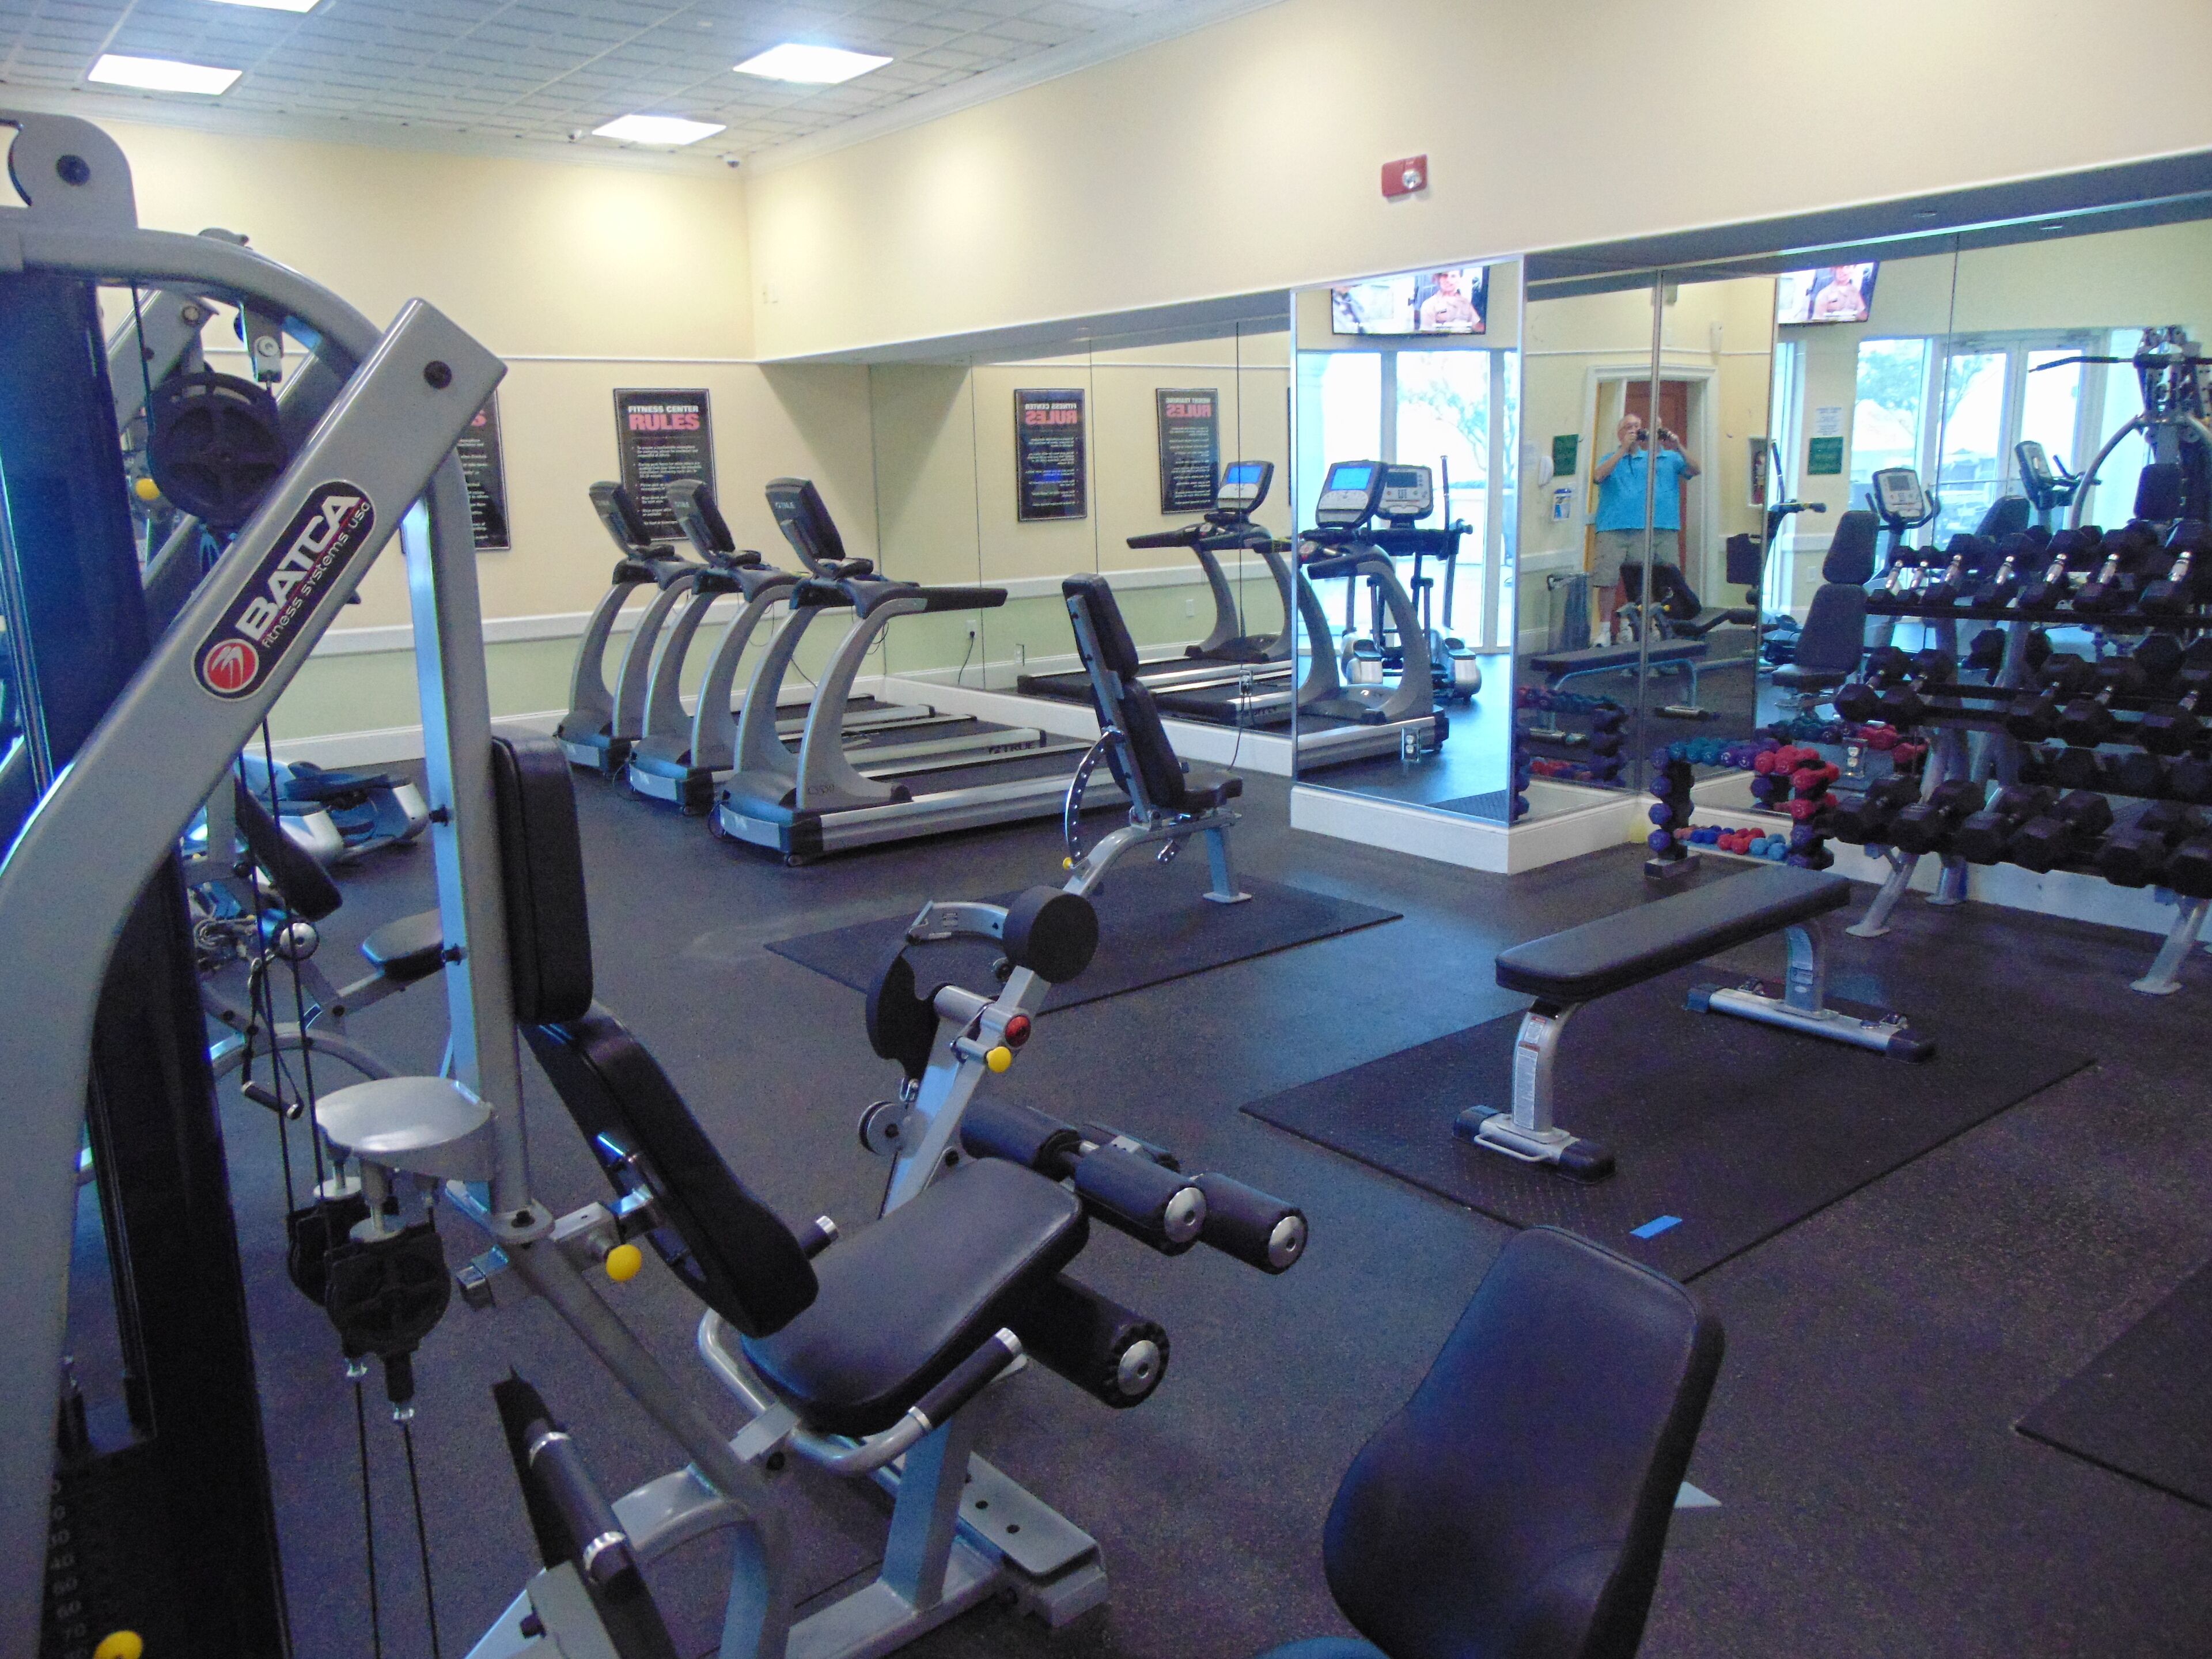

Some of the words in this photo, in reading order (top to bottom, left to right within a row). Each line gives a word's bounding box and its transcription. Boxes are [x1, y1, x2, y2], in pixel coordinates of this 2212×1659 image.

[628, 405, 664, 413] FITNESS
[666, 405, 699, 413] CENTER
[628, 414, 700, 430] RULES
[234, 496, 361, 642] BATCA
